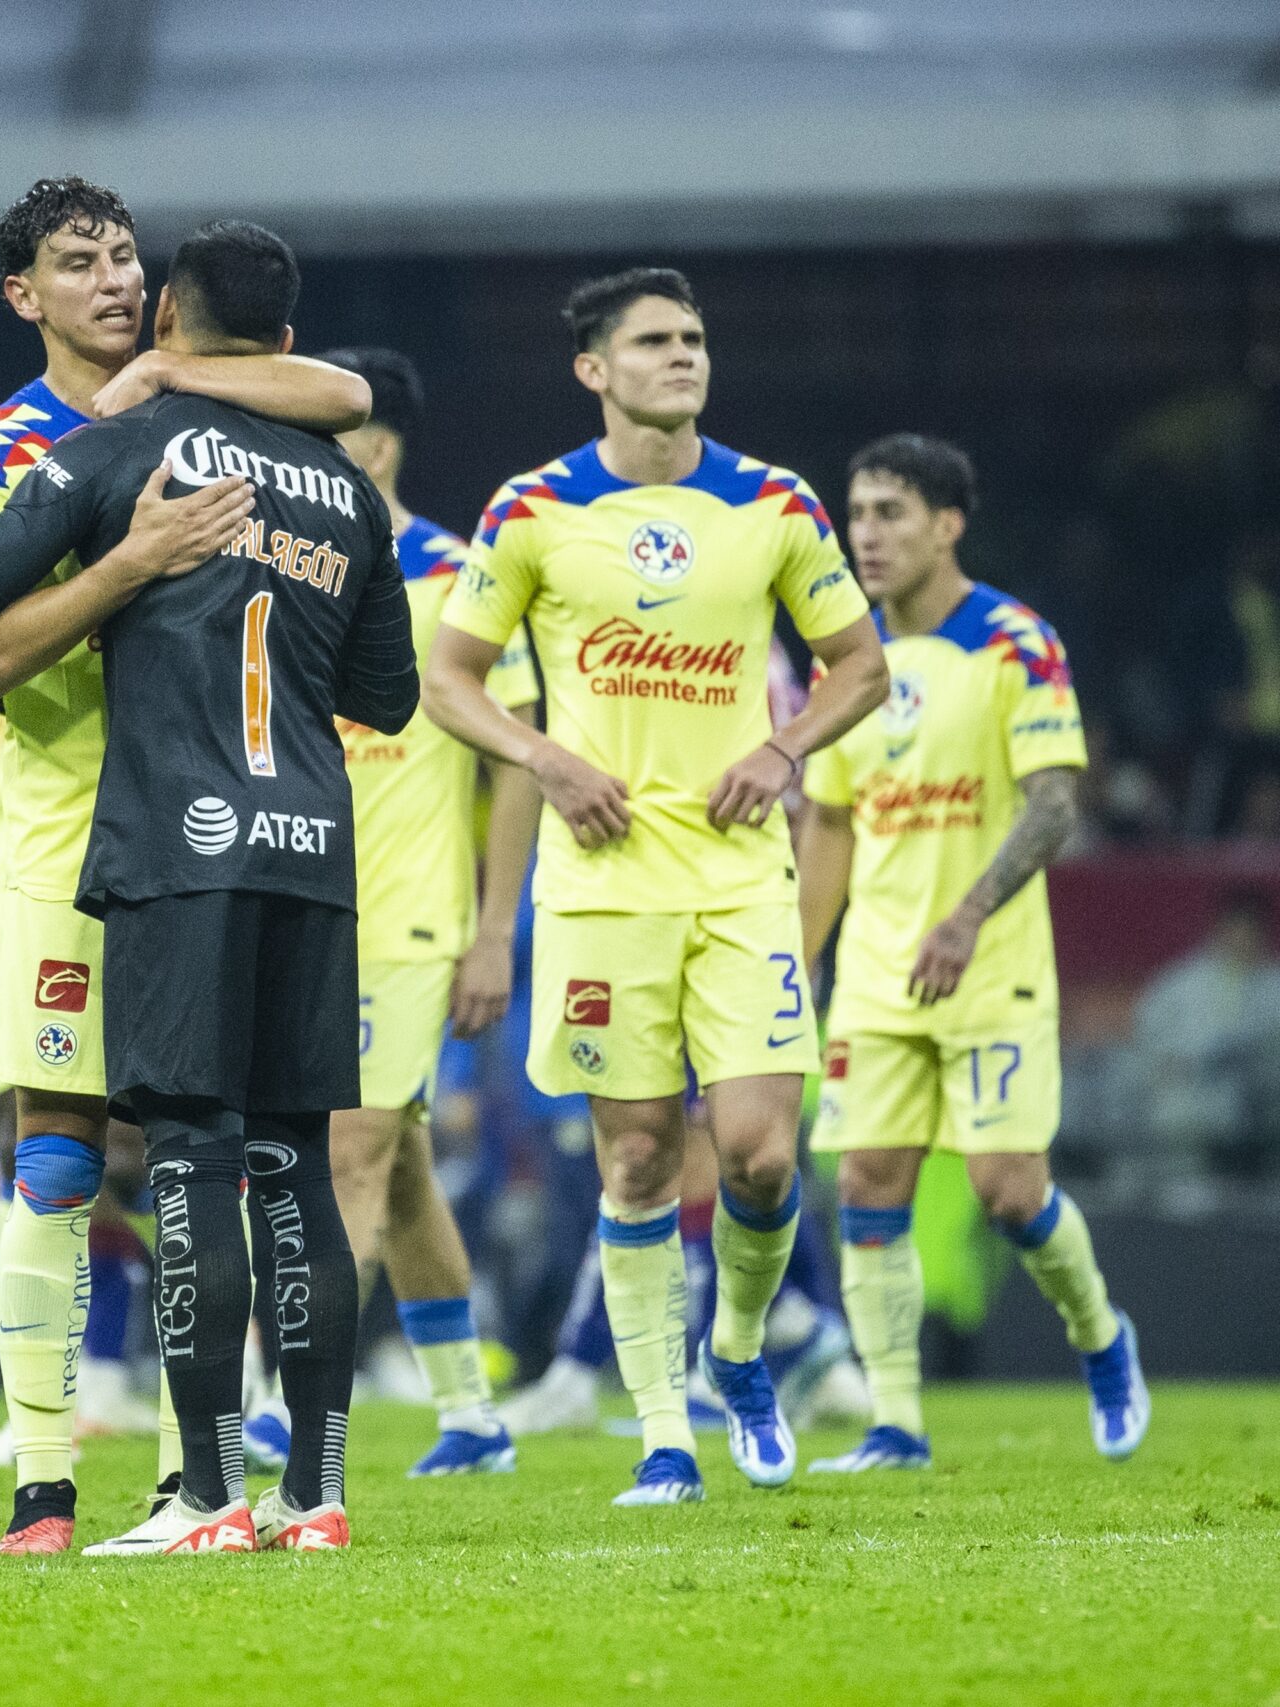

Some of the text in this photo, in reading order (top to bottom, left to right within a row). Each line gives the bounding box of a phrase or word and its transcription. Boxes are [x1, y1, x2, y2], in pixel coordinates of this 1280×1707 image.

[164, 427, 356, 520] Corona
[221, 517, 350, 597] ALAGÓN
[578, 616, 745, 677] Caliente
[242, 591, 277, 778] 1
[591, 673, 737, 707] caliente.mx
[246, 811, 336, 855] AT&T
[768, 953, 802, 1019] 3
[969, 1042, 1021, 1104] 17
